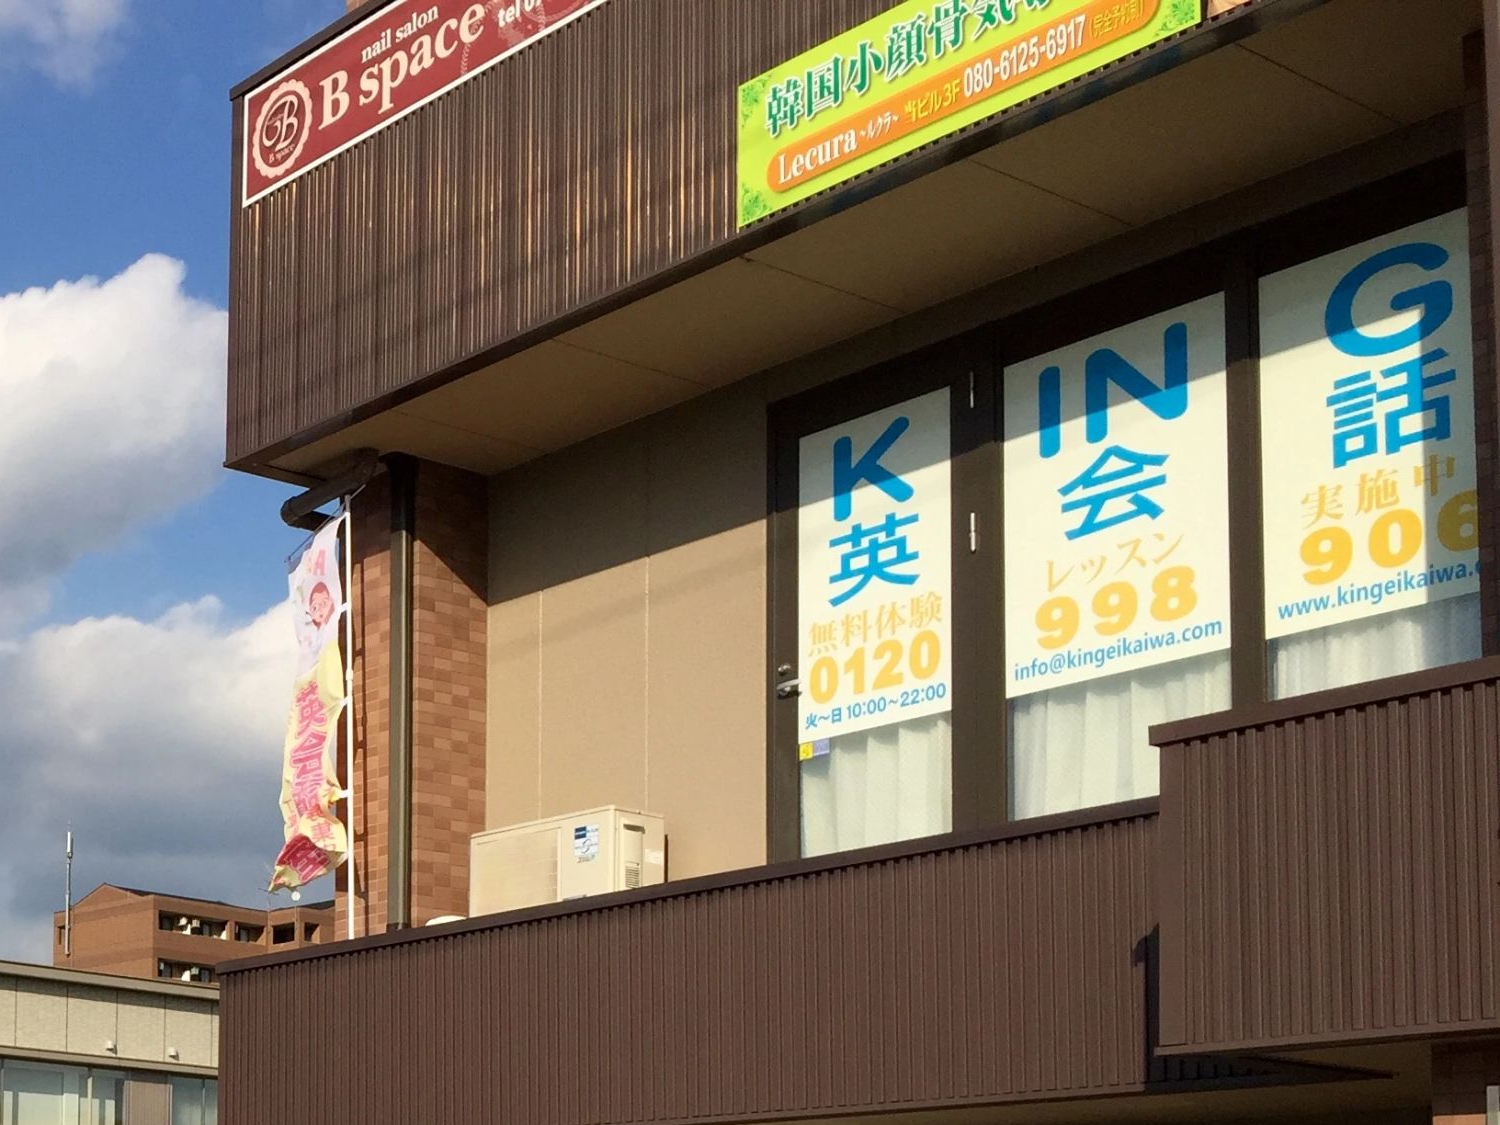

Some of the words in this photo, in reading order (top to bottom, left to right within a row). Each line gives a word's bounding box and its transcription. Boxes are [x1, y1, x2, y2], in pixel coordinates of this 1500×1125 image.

[317, 71, 350, 130] B
[358, 2, 486, 114] space
[361, 28, 391, 63] nail
[394, 4, 439, 45] salon
[498, 0, 521, 27] tel
[763, 0, 1049, 139] 韓国小顔骨気
[777, 130, 857, 185] Lecura
[963, 13, 1086, 98] 080-6125-6917
[832, 415, 915, 523] K
[1323, 241, 1455, 358] G
[829, 512, 920, 608] 英
[1057, 444, 1171, 541] 会
[1325, 347, 1457, 470] 話
[807, 591, 945, 658] 無料体験
[1046, 531, 1185, 593] レッスン
[1299, 453, 1457, 529] 実施中
[809, 629, 942, 705] 0120
[1035, 564, 1198, 651] 998
[1013, 620, 1223, 682] info@kingeikaiwa.com
